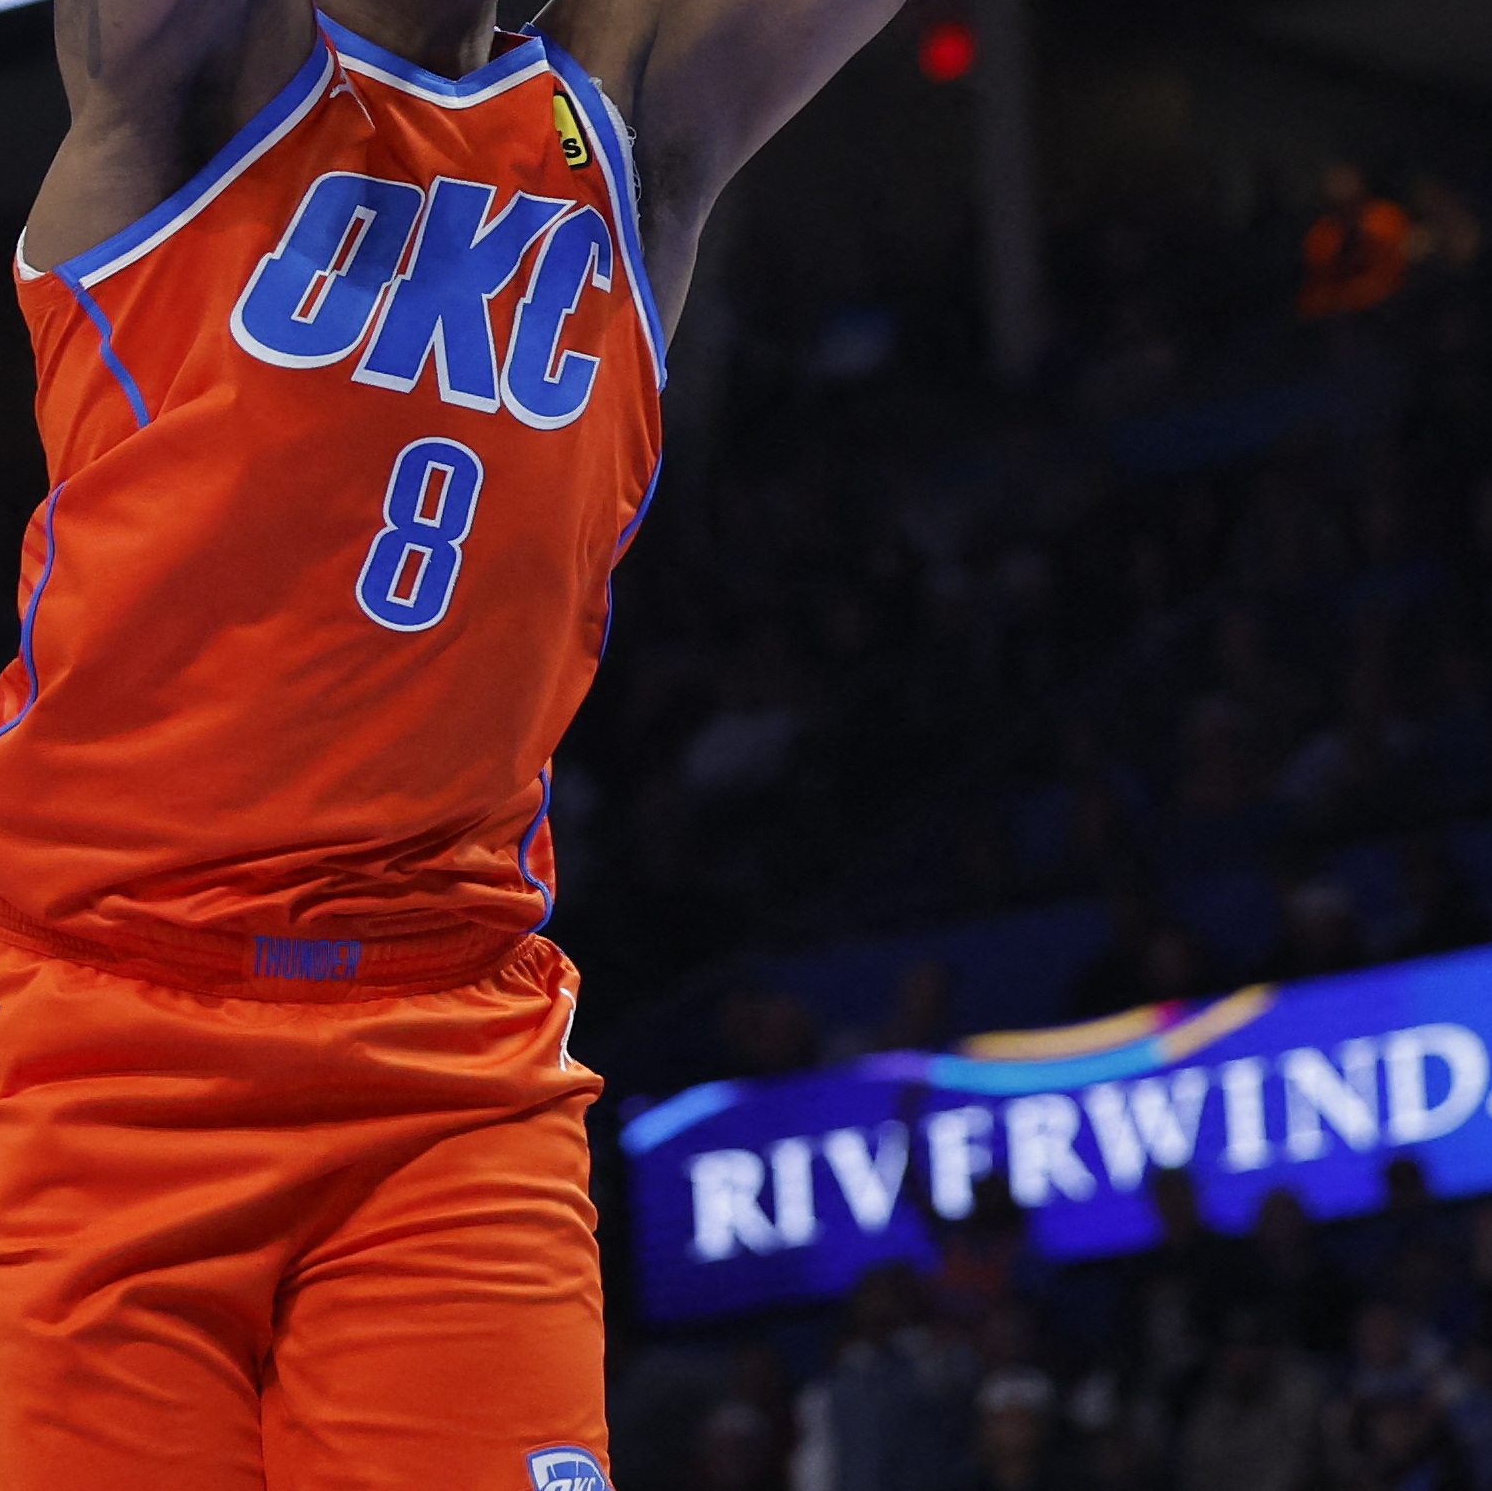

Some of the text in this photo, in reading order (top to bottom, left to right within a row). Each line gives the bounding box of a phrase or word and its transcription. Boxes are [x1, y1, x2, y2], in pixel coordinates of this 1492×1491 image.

[229, 170, 612, 431] OKC
[355, 435, 485, 632] 8
[253, 935, 362, 981] THUNDER
[687, 1022, 1491, 1263] RIVERWIND
